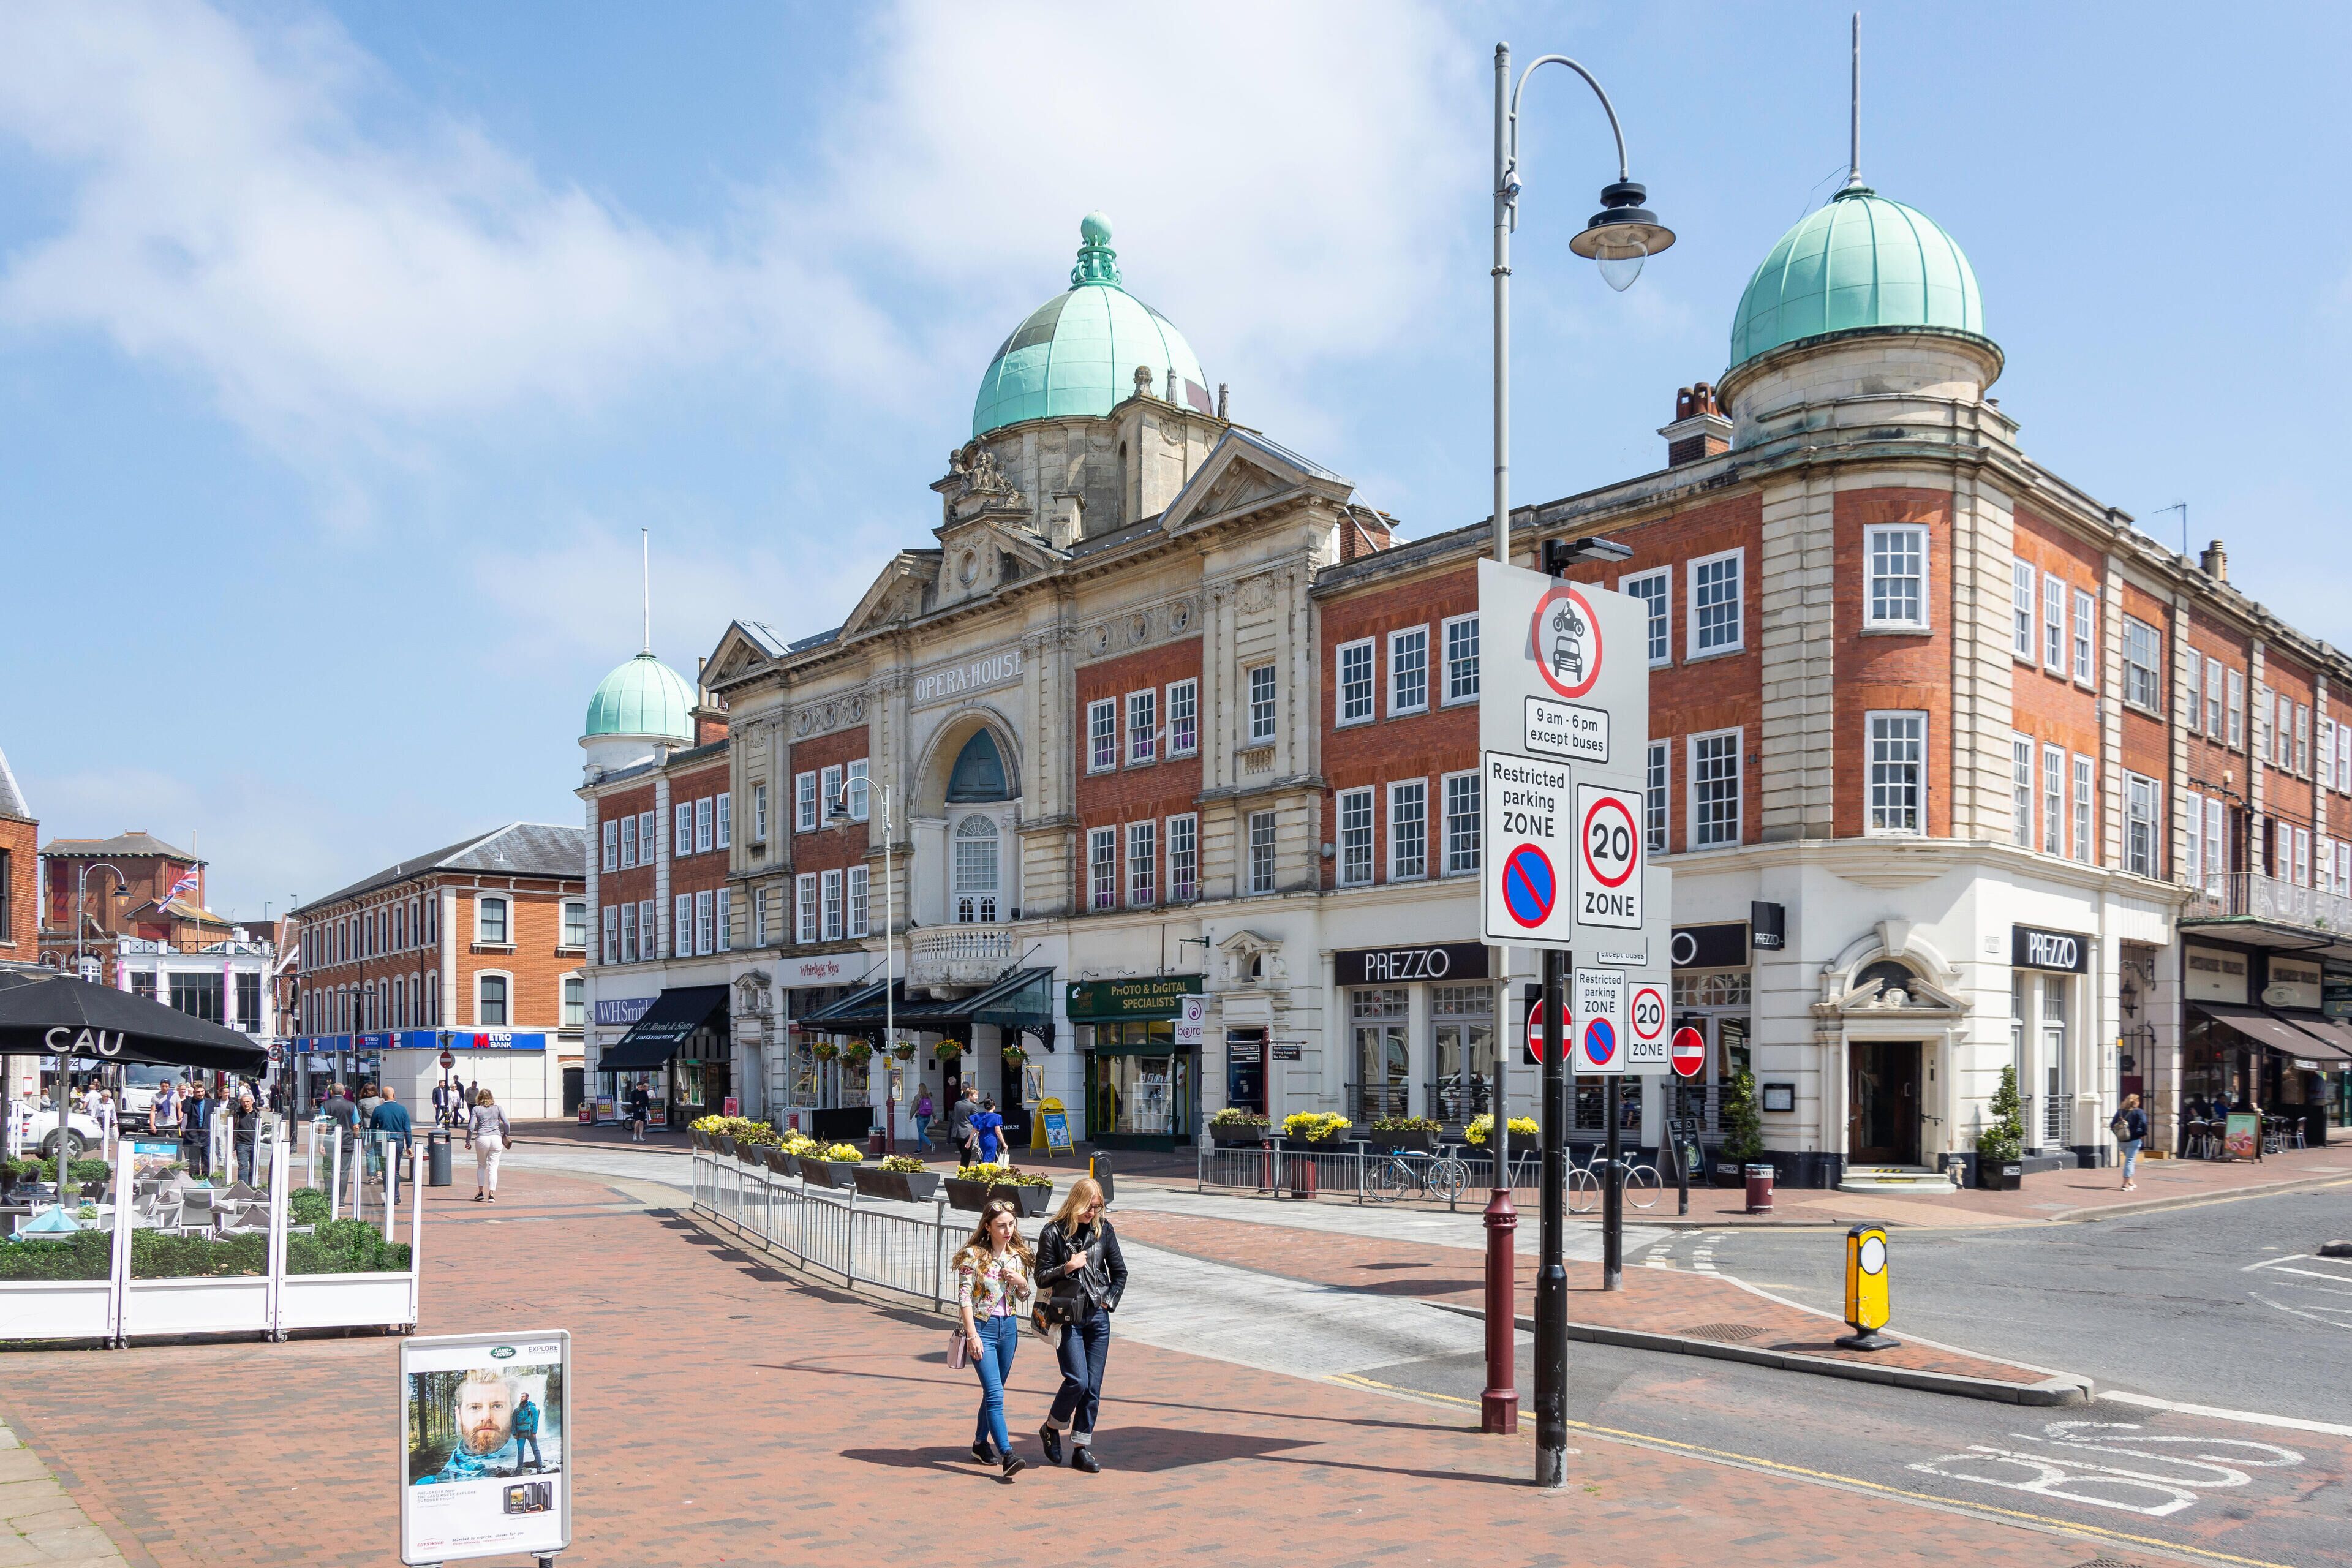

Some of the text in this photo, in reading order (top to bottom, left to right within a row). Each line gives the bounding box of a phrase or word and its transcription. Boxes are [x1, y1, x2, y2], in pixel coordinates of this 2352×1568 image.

[971, 651, 1024, 687] HOUSE
[1537, 707, 1544, 722] 9
[1547, 713, 1562, 725] am
[1572, 714, 1579, 728] 6
[1582, 719, 1597, 732] pm
[1531, 729, 1604, 752] except buses
[1493, 761, 1564, 789] Restricted
[1503, 790, 1555, 813] parking
[1503, 811, 1555, 838] ZONE
[1592, 823, 1630, 862] 20
[1585, 892, 1634, 917] ZONE
[1755, 932, 1779, 946] PREZZO
[2028, 932, 2077, 969] PREZZO
[826, 960, 839, 976] Toys
[1365, 949, 1450, 981] PREZZO
[1112, 982, 1187, 995] PHOTO & DIGITAL
[1579, 973, 1621, 985] Restricted
[1123, 997, 1175, 1009] SPECIALISTS
[1585, 987, 1615, 999] parking
[1585, 1000, 1615, 1013] ZONE
[1637, 1003, 1660, 1025] 20
[649, 1022, 669, 1031] Rook
[676, 1022, 695, 1030] Sons
[45, 1027, 124, 1056] CAU
[473, 1033, 512, 1048] METRO
[1632, 1044, 1663, 1056] ZONE
[1904, 1421, 2305, 1517] BUS
